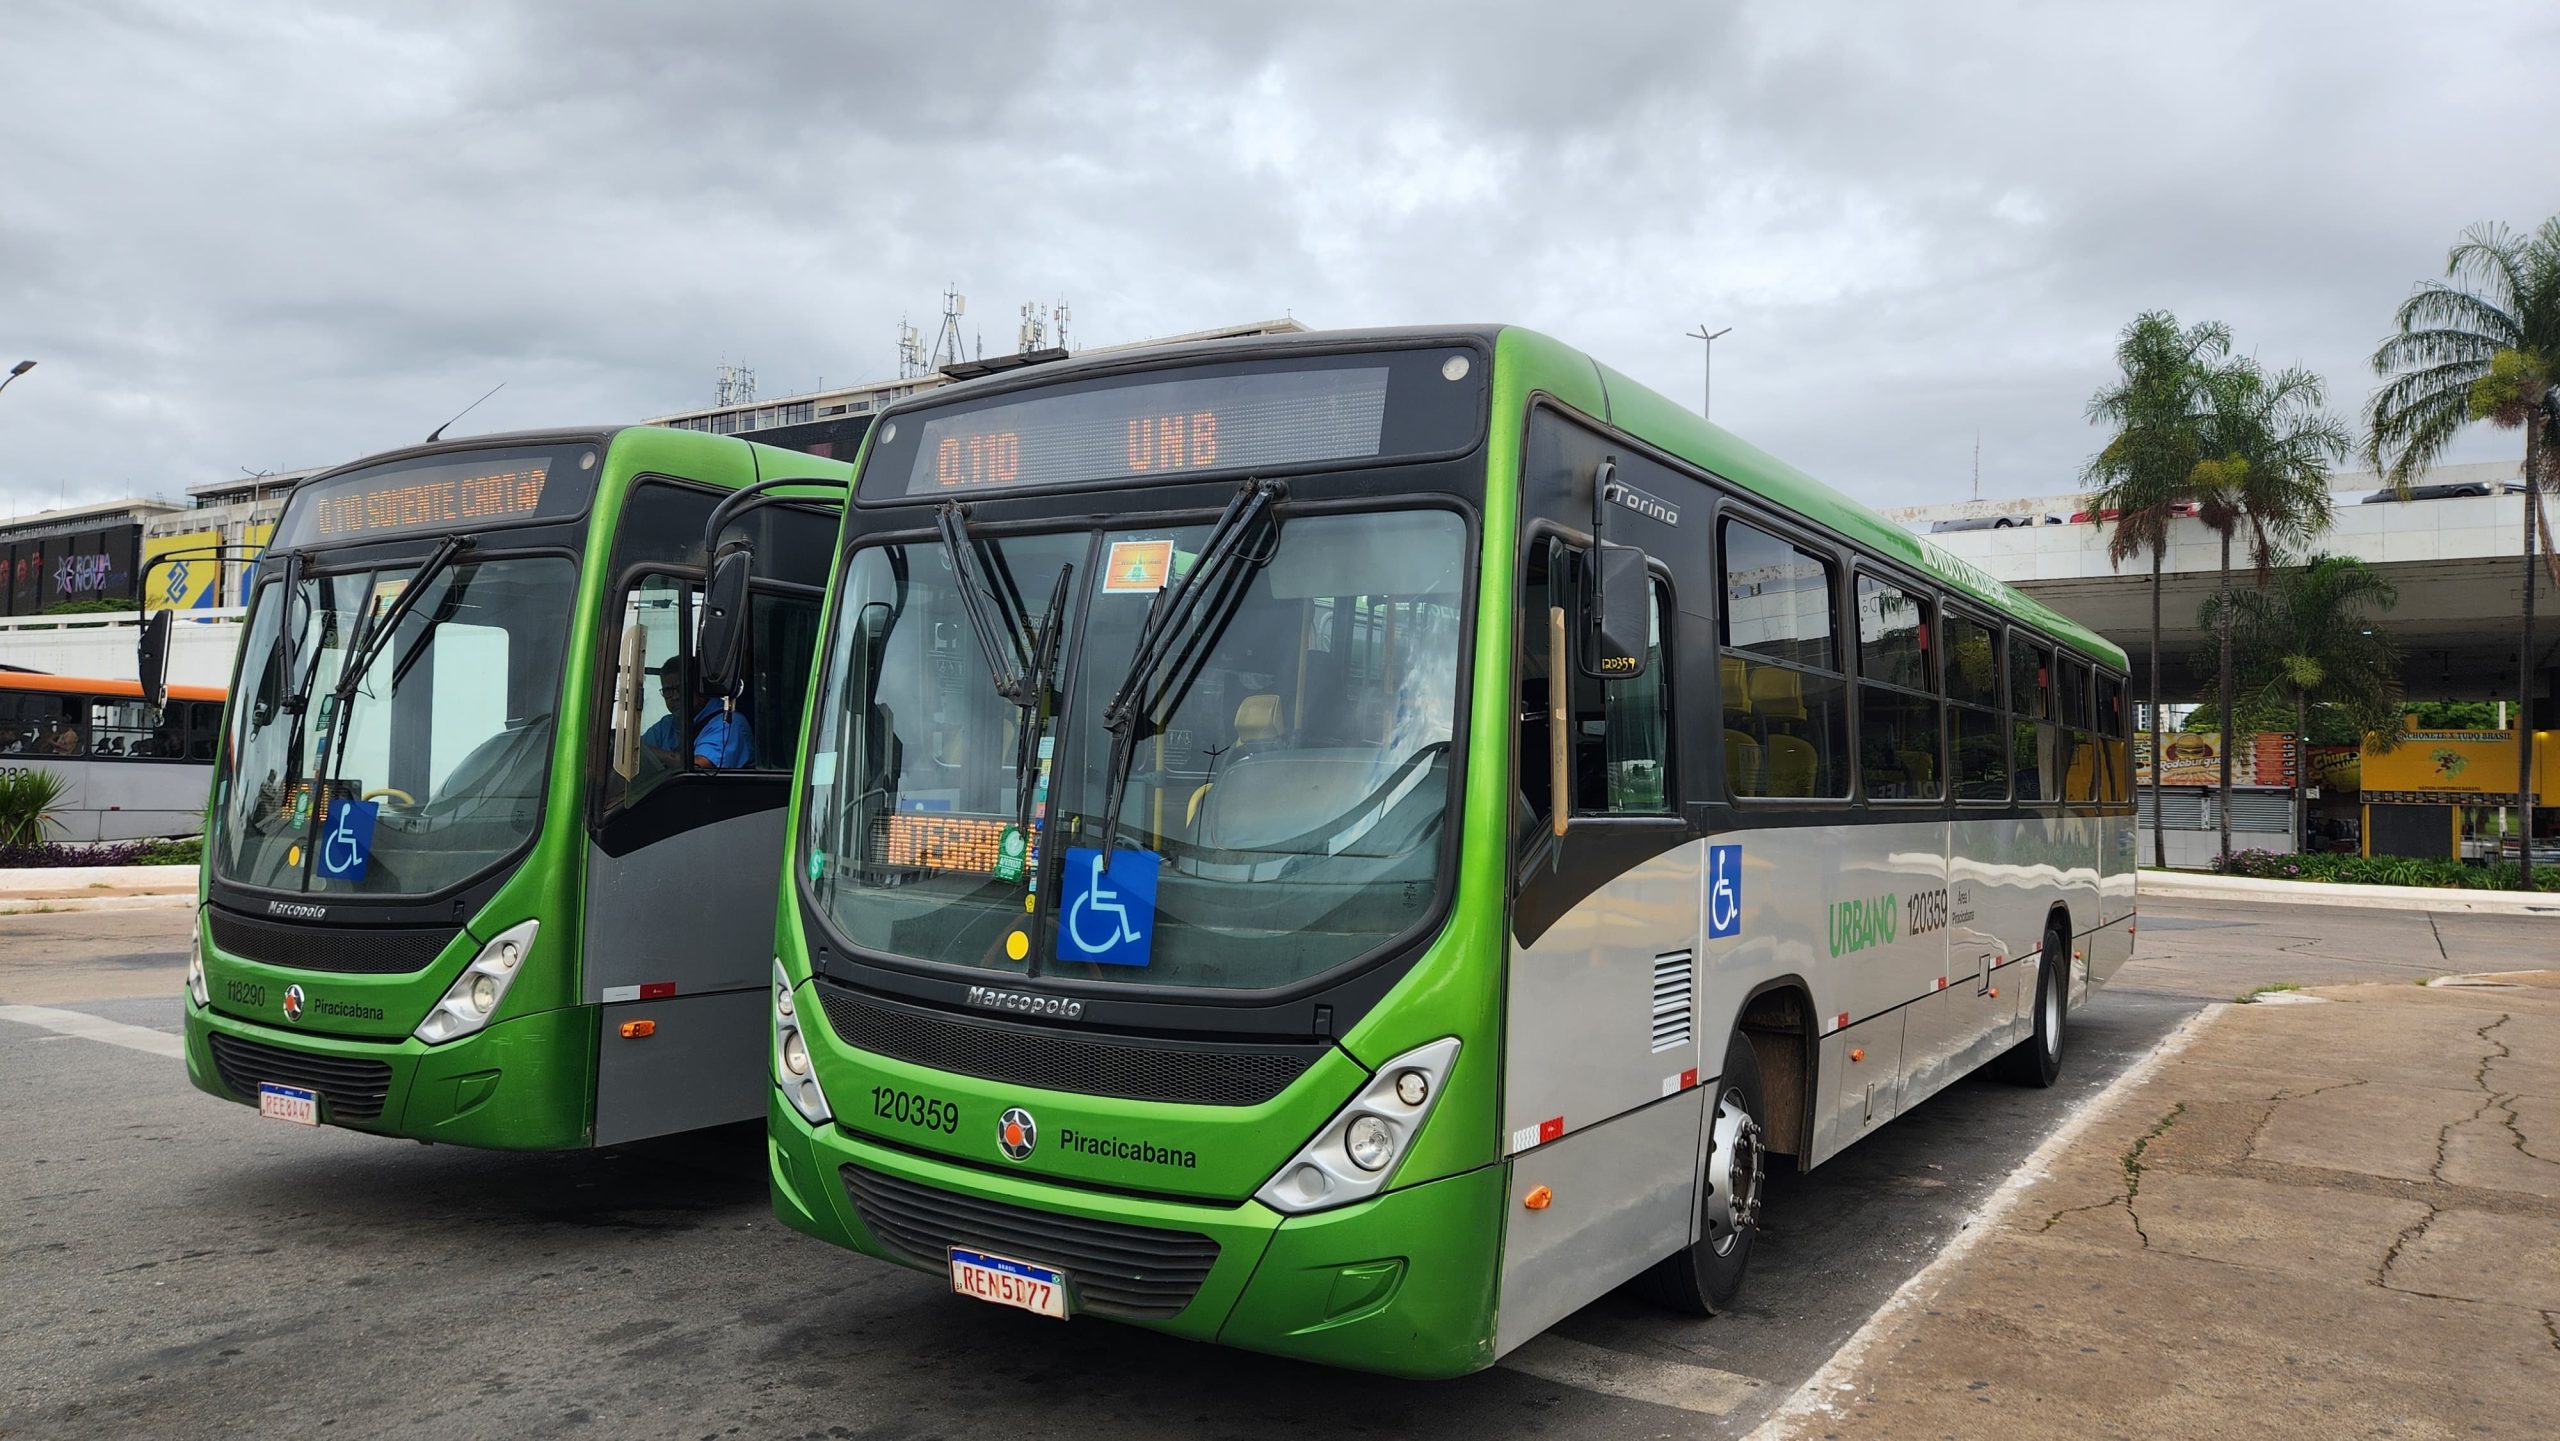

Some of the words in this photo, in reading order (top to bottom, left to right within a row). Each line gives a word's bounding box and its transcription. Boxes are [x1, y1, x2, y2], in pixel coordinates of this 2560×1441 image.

[938, 432, 1019, 486] 0.110
[319, 495, 363, 534] 0.110
[368, 481, 456, 528] SOMENTE
[1615, 484, 1678, 524] Torino
[74, 571, 107, 592] NOVA
[1602, 657, 1636, 671] 120359
[2457, 732, 2480, 740] TUDO
[2481, 732, 2513, 741] BRASIL
[267, 901, 326, 918] Marcopolo
[1829, 893, 1897, 959] URBANO
[1907, 888, 1948, 936] 120359
[227, 981, 265, 1007] 118290
[314, 998, 384, 1020] Piracicabana
[967, 986, 1081, 1016] Marcopolo
[872, 1086, 959, 1134] 120359
[1060, 1128, 1196, 1168] Piracicabana
[963, 1266, 1051, 1310] REN5D77
